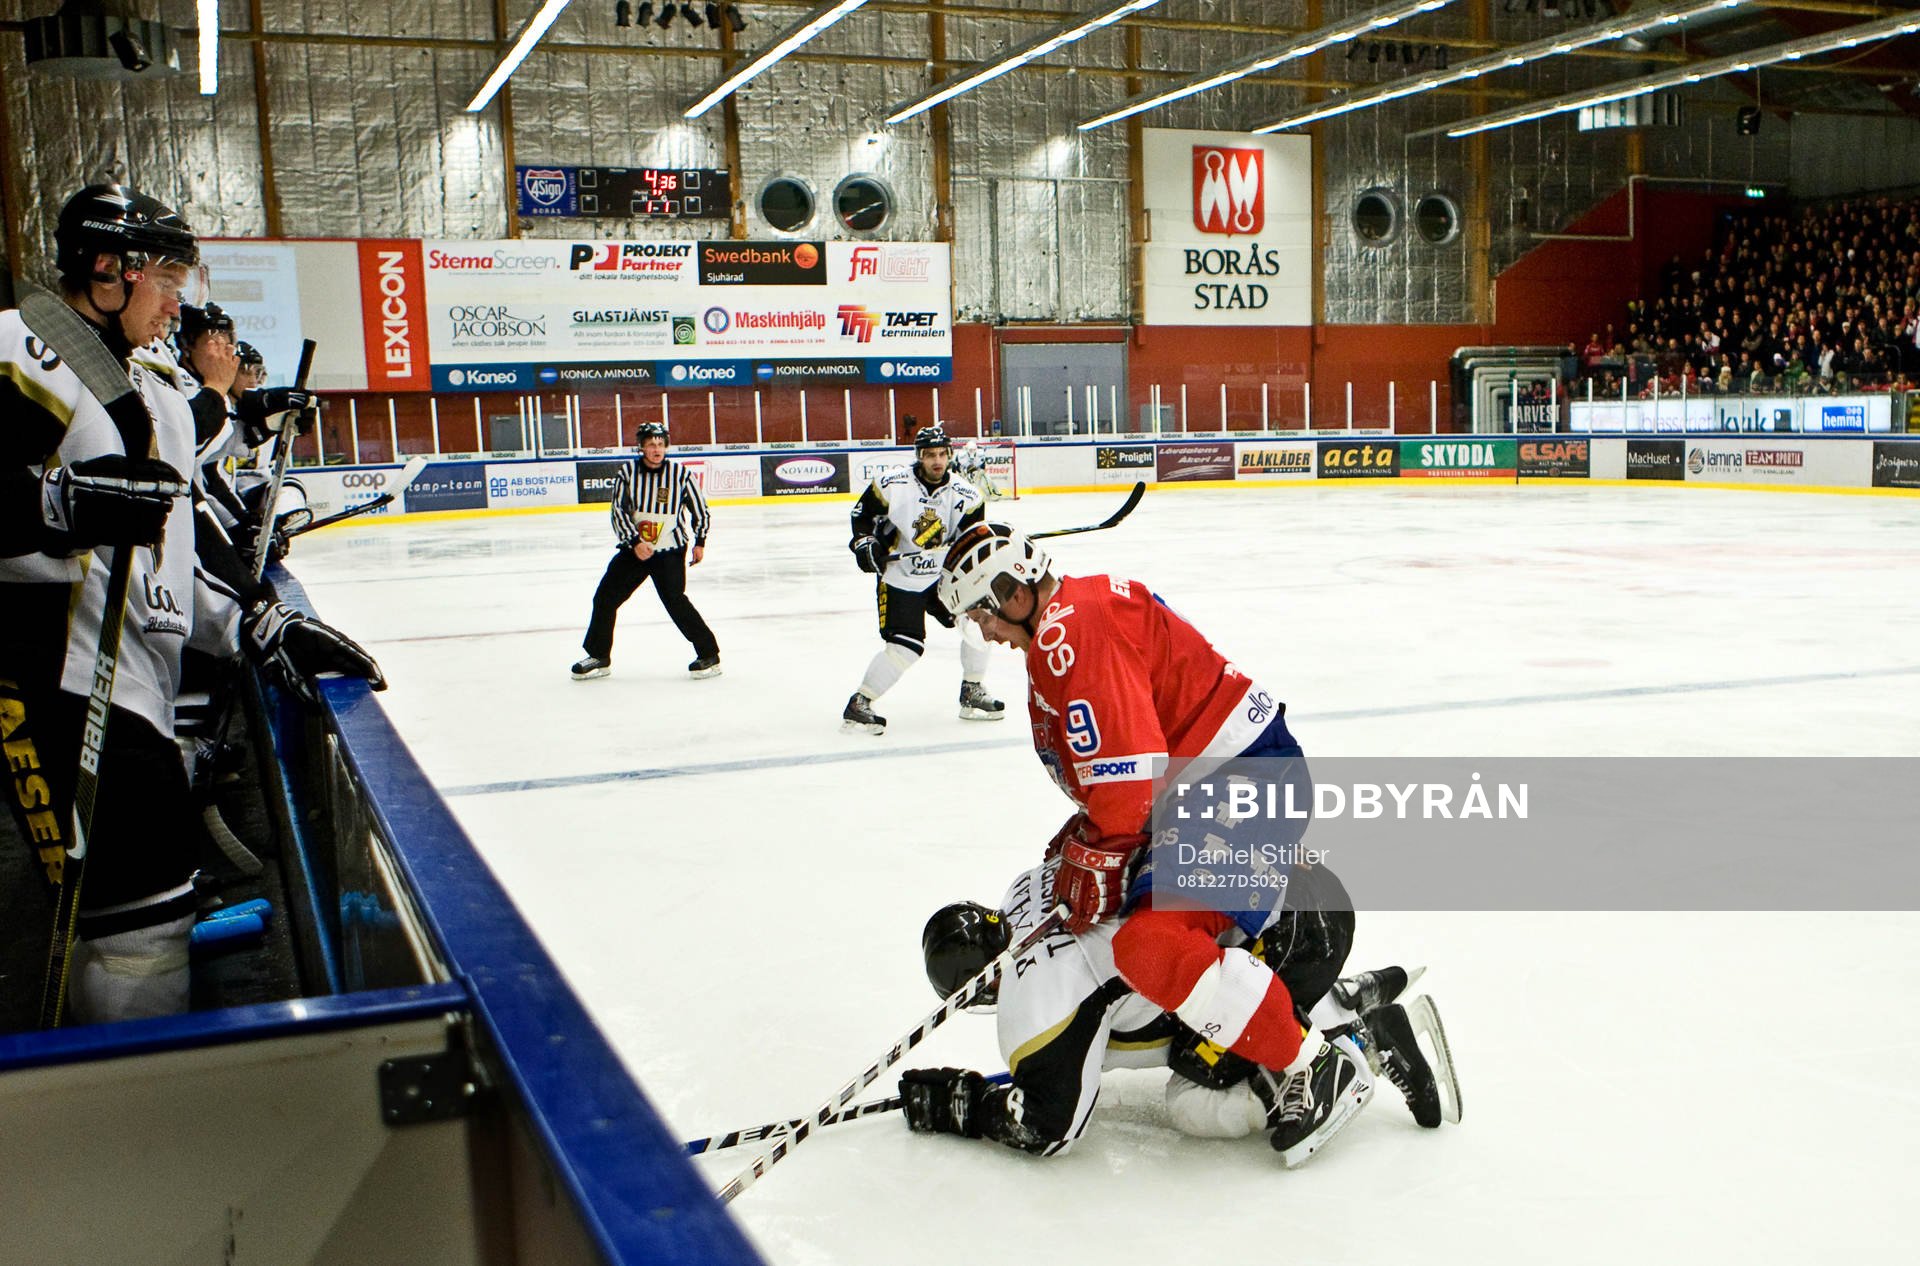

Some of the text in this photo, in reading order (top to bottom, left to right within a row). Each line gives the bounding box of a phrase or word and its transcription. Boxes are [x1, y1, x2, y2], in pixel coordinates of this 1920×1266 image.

[531, 180, 561, 200] 4Sign
[82, 220, 125, 233] BAUER
[622, 244, 692, 257] PROJEKT
[705, 248, 791, 264] Swedbank
[621, 258, 684, 271] Partner
[1184, 243, 1280, 276] BORÅS
[706, 272, 744, 283] Sjuhärad
[1195, 283, 1269, 310] STAD
[377, 250, 412, 379] LEXICON
[573, 308, 670, 323] GLASTJÄNST
[735, 310, 826, 330] Maskinhjälp
[885, 312, 938, 327] TAPET
[452, 321, 546, 340] JACOBSON
[881, 327, 945, 338] terminalen
[467, 369, 517, 385] Koneo
[560, 368, 650, 379] KONICA MINOLTA
[689, 365, 736, 380] Koneo
[776, 364, 860, 376] KONICA MINOLTA
[896, 362, 940, 377] Koneo
[1823, 411, 1863, 428] hemma
[1119, 451, 1153, 464] Prolight
[1241, 449, 1311, 467] BLÅKLÄDER
[1324, 445, 1393, 467] acta
[1421, 443, 1495, 467] SKYDDA
[1520, 443, 1588, 460] ELSAFE
[1628, 451, 1671, 465] MacHuset
[1707, 449, 1742, 467] lamina
[1747, 451, 1801, 465] TEAM SPORTIA
[781, 465, 831, 475] NOVAFLEX
[342, 472, 386, 490] coop
[408, 480, 482, 492] temp-team
[511, 475, 574, 485] AB BOSTÄDER
[516, 487, 548, 496] BORÅS
[775, 485, 838, 494] www.novaflex.se
[954, 500, 965, 512] A
[1013, 563, 1026, 574] 9
[80, 651, 116, 776] BAUER
[1066, 699, 1102, 757] 9
